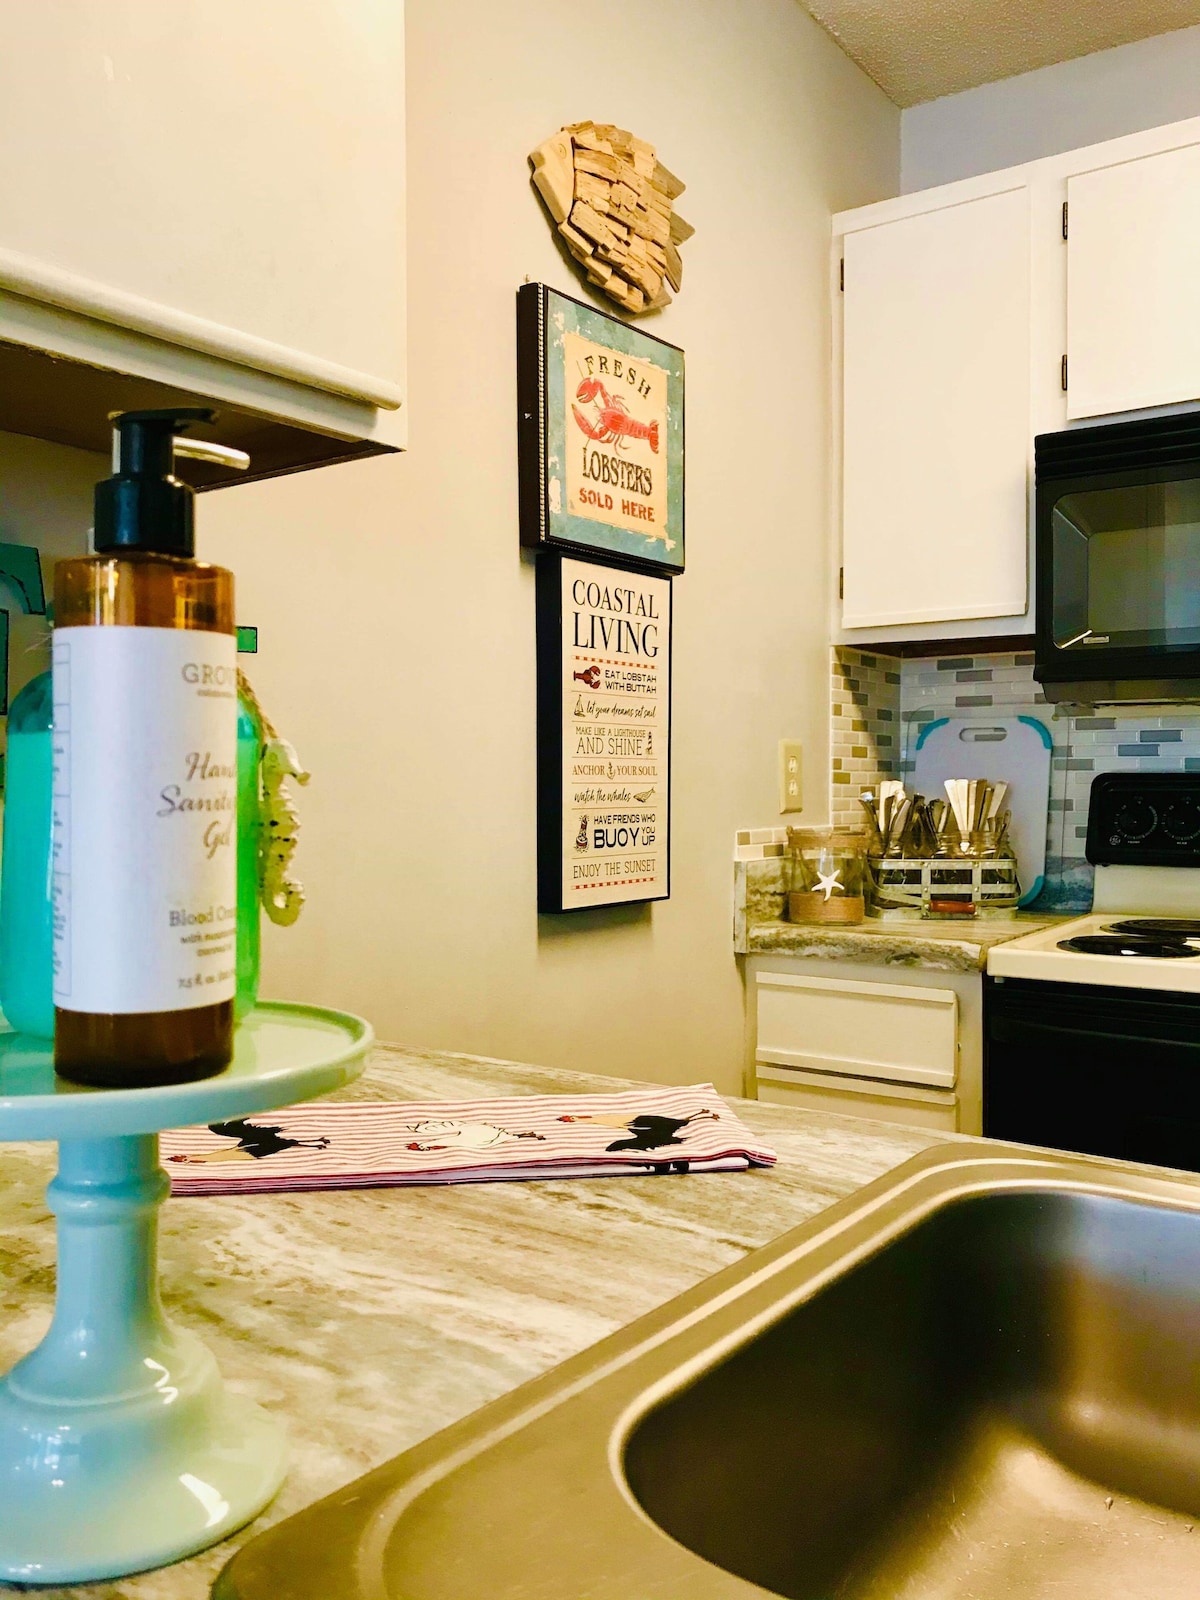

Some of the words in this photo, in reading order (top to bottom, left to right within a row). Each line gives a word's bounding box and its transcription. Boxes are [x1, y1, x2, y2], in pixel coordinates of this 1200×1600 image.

[584, 355, 652, 401] FRESH
[582, 447, 653, 497] LOBSTERS
[579, 487, 613, 511] SOLD
[622, 498, 655, 522] HERE
[572, 579, 659, 619] COASTAL
[572, 611, 659, 658] LIVING
[605, 669, 620, 679] EAT
[622, 671, 656, 683] LOBSTAH
[605, 681, 625, 691] WITH
[626, 683, 656, 694] BUTTAH
[586, 700, 596, 714] let
[595, 706, 610, 719] your
[611, 702, 634, 717] dreams
[634, 705, 644, 718] set
[644, 706, 657, 718] sail
[575, 726, 592, 735] MAKE
[594, 727, 606, 736] LIKE
[607, 728, 612, 736] A
[614, 728, 646, 738] LIGHTHOUSE
[576, 736, 604, 754] AND
[608, 737, 643, 756] SHINE
[572, 765, 605, 776] ANCHOR
[616, 765, 637, 776] YOUR
[638, 766, 658, 776] SOUL
[574, 788, 595, 804] watch
[595, 788, 606, 804] the
[607, 787, 631, 802] whales
[594, 815, 612, 825] HAVE
[612, 814, 640, 824] FRIENDS
[641, 813, 656, 823] WHO
[593, 827, 640, 849] BUOY
[641, 826, 656, 834] YOU
[642, 835, 656, 846] UP
[573, 863, 601, 879] ENJOY
[604, 862, 621, 876] THE
[624, 859, 656, 874] SUNSET
[169, 905, 214, 927] Blood
